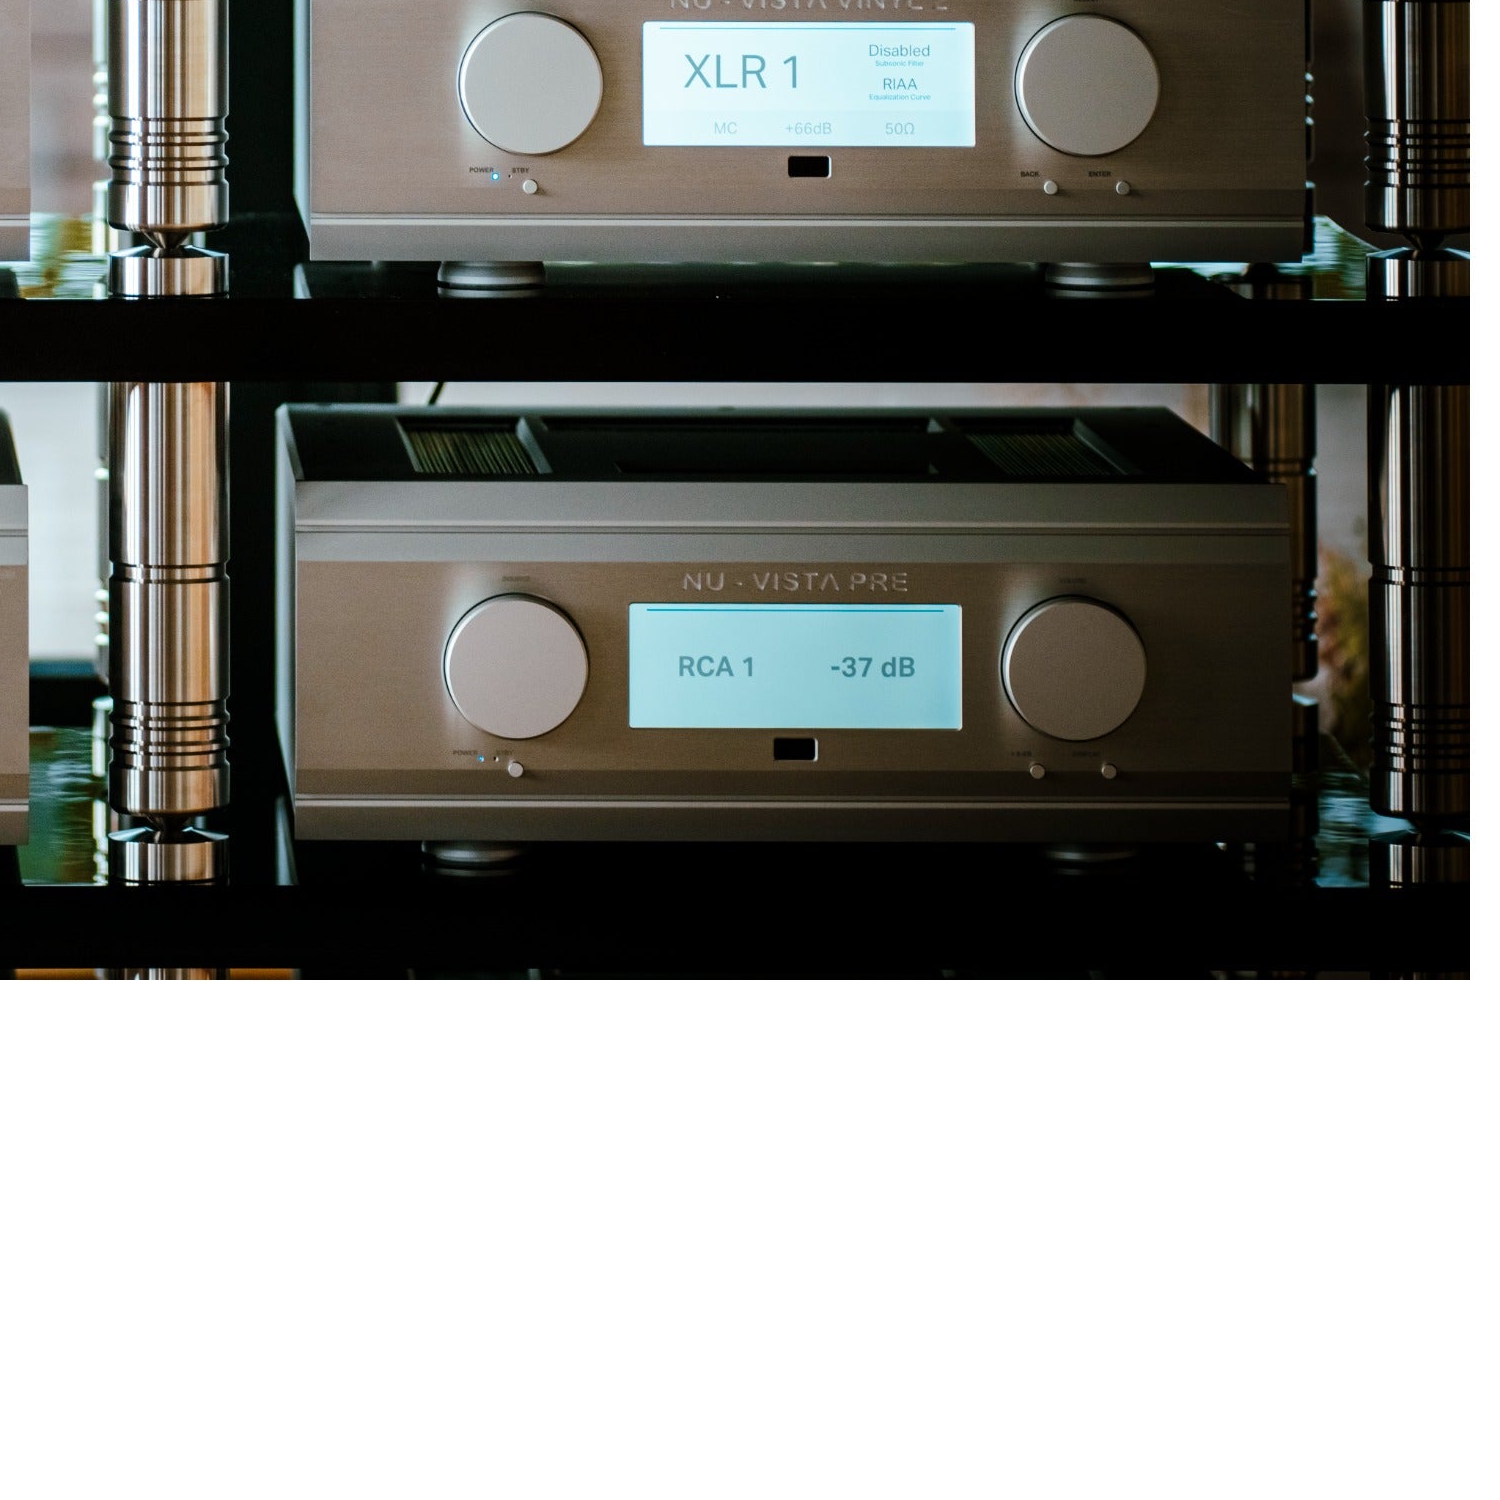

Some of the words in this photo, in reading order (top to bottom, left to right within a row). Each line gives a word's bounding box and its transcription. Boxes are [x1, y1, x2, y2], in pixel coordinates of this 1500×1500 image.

[869, 44, 930, 57] Disabled
[684, 54, 767, 88] XLR
[783, 55, 797, 88] 1
[883, 78, 917, 90] RIAA
[714, 122, 737, 135] MC
[786, 122, 832, 135] +66dB
[885, 122, 915, 135] 50Ω
[682, 572, 724, 591] NU
[753, 572, 840, 591] VISTA
[850, 572, 908, 592] PRE
[679, 656, 734, 677] RCA
[742, 656, 753, 677] 1
[831, 657, 873, 677] -37
[881, 657, 916, 677] dB
